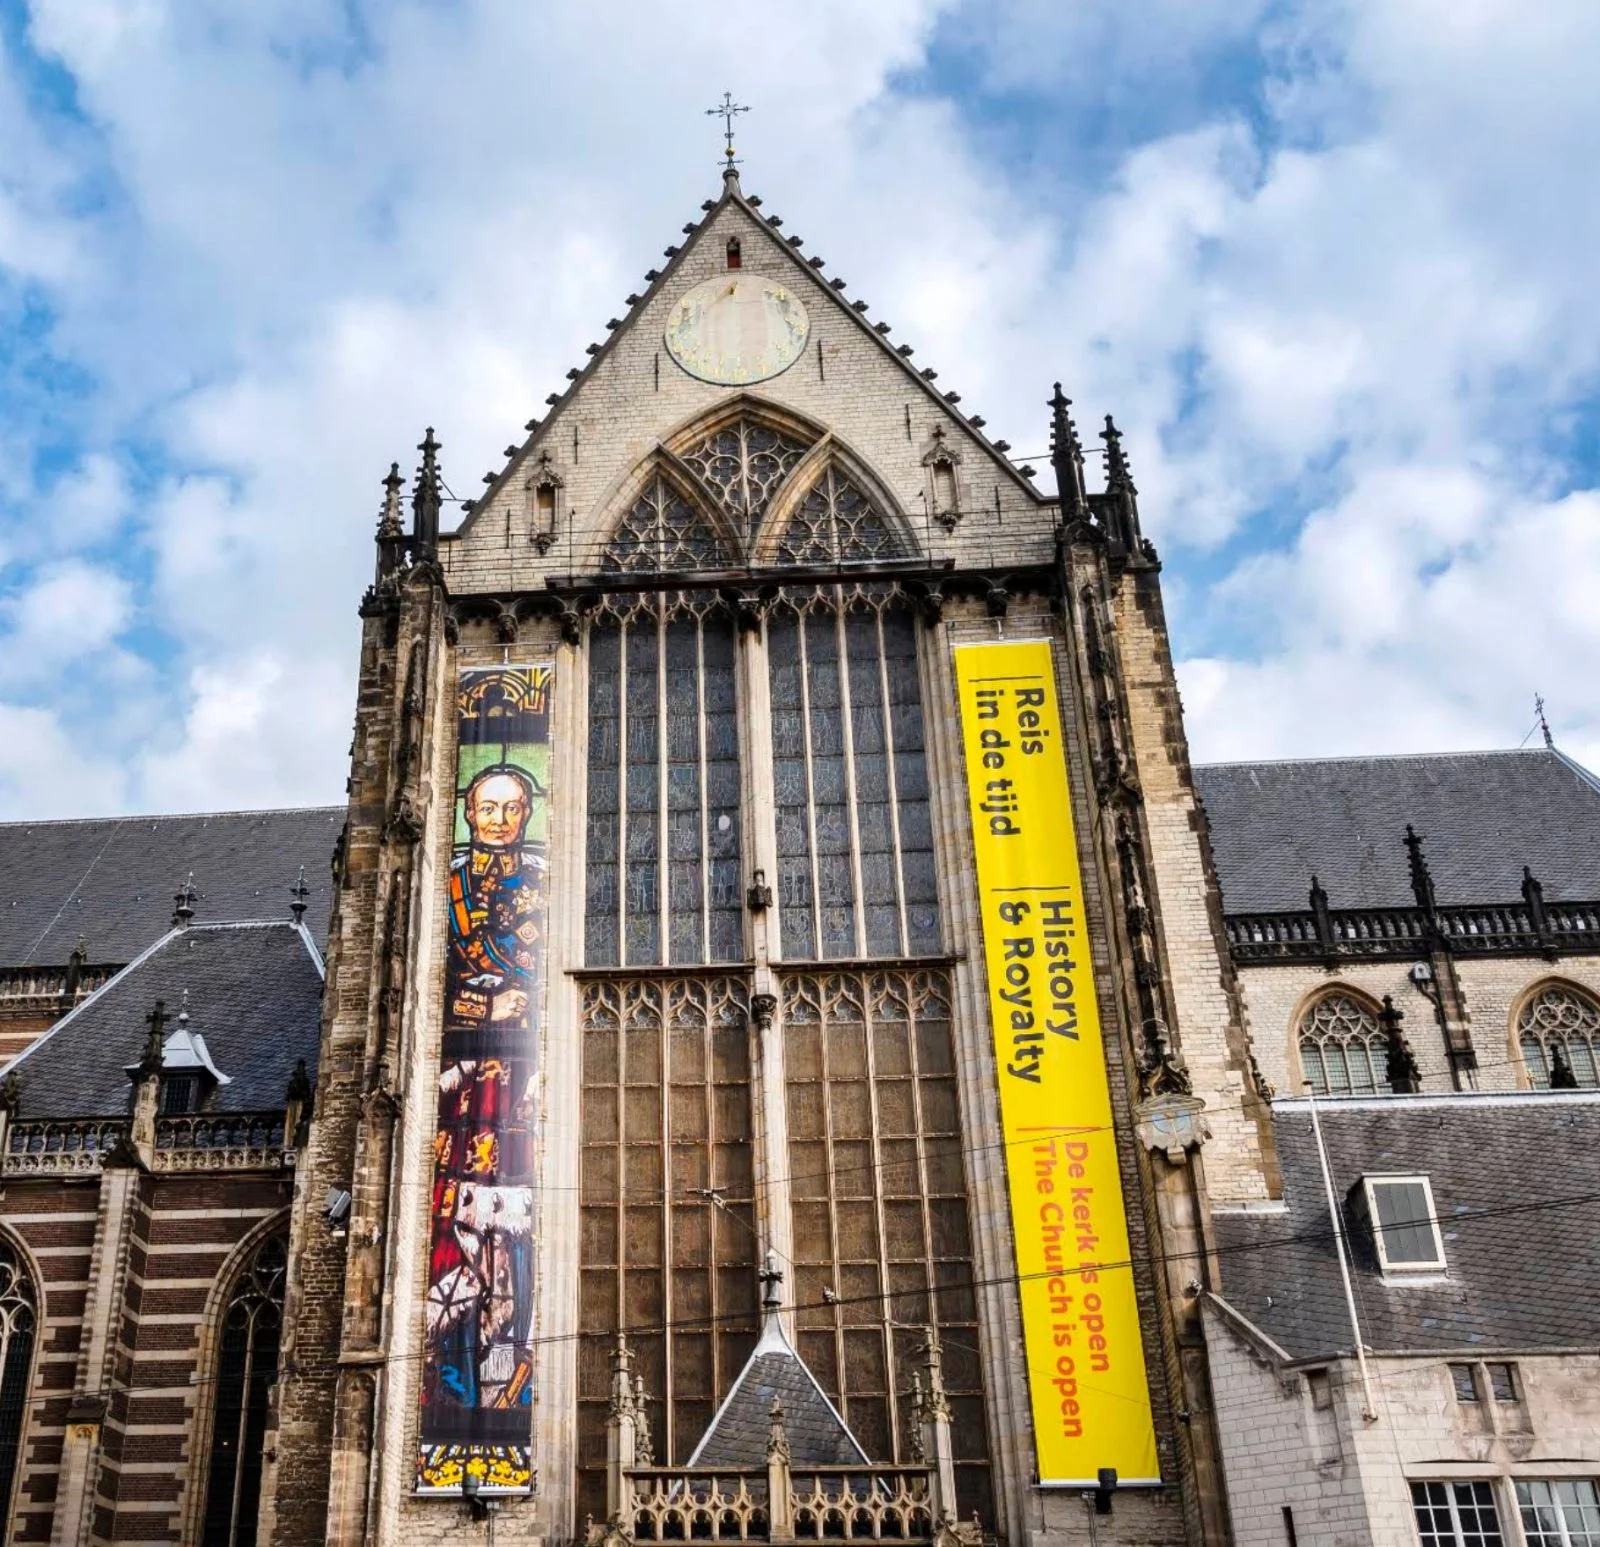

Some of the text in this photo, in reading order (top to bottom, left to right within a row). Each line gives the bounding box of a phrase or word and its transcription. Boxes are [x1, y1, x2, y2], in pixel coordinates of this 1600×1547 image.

[975, 689, 1021, 837] in de tijd
[1014, 687, 1050, 756] Reis
[998, 901, 1045, 1084] & Royalty
[1040, 900, 1080, 1042] History
[1033, 1140, 1083, 1438] The Church is open
[1065, 1141, 1110, 1372] De kerk is open
